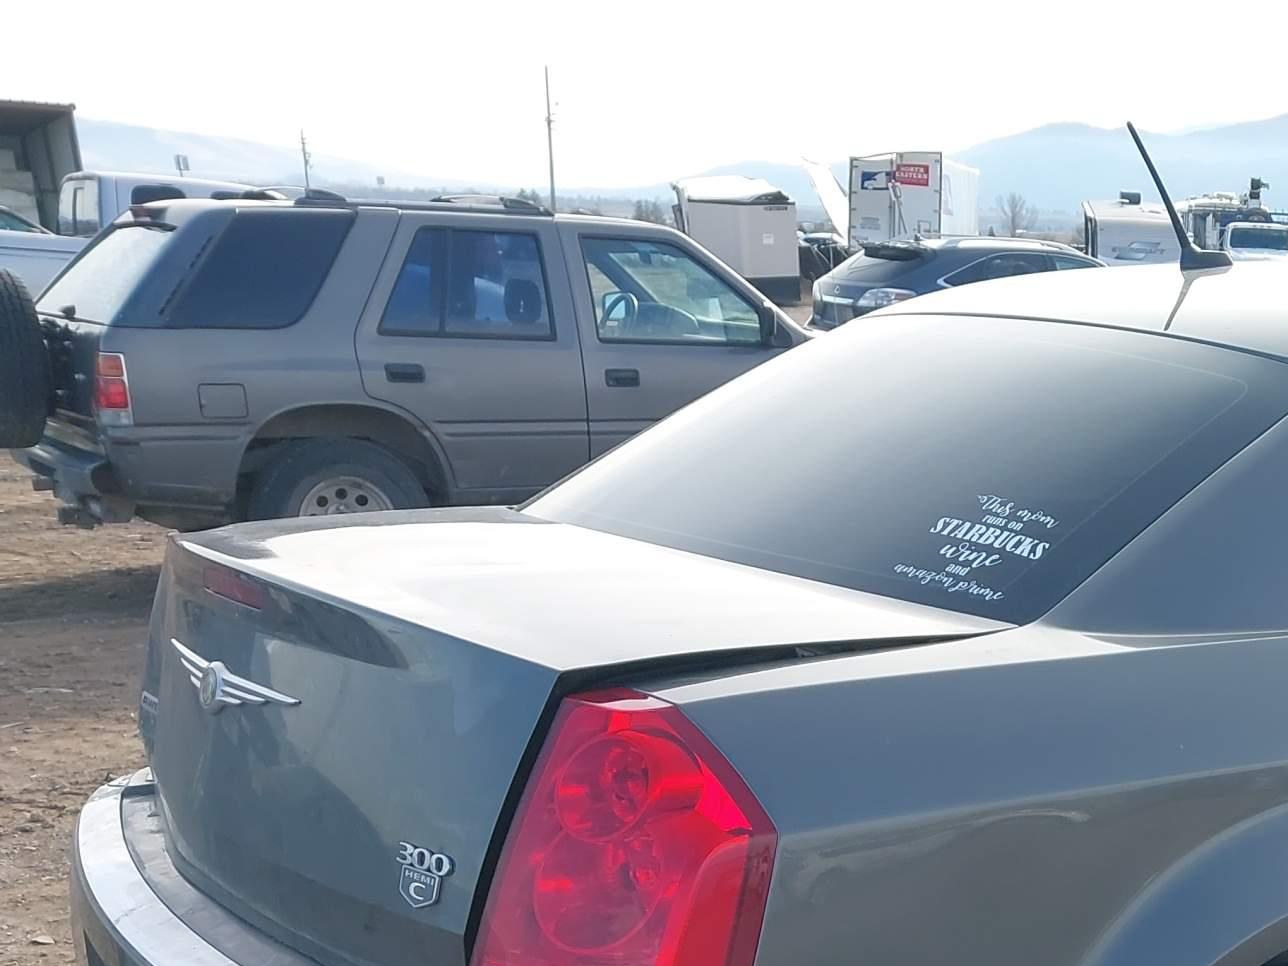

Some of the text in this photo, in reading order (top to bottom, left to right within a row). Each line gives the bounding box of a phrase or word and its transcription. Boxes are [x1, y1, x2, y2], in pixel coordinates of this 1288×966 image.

[977, 494, 1060, 528] This mom
[982, 514, 1024, 531] runs on
[930, 517, 1050, 560] STARBUCKS
[939, 543, 1002, 568] wine
[893, 562, 1005, 601] amazon prime
[945, 563, 970, 577] and
[396, 841, 451, 877] 300
[404, 869, 435, 886] HEMI
[408, 881, 426, 901] C
